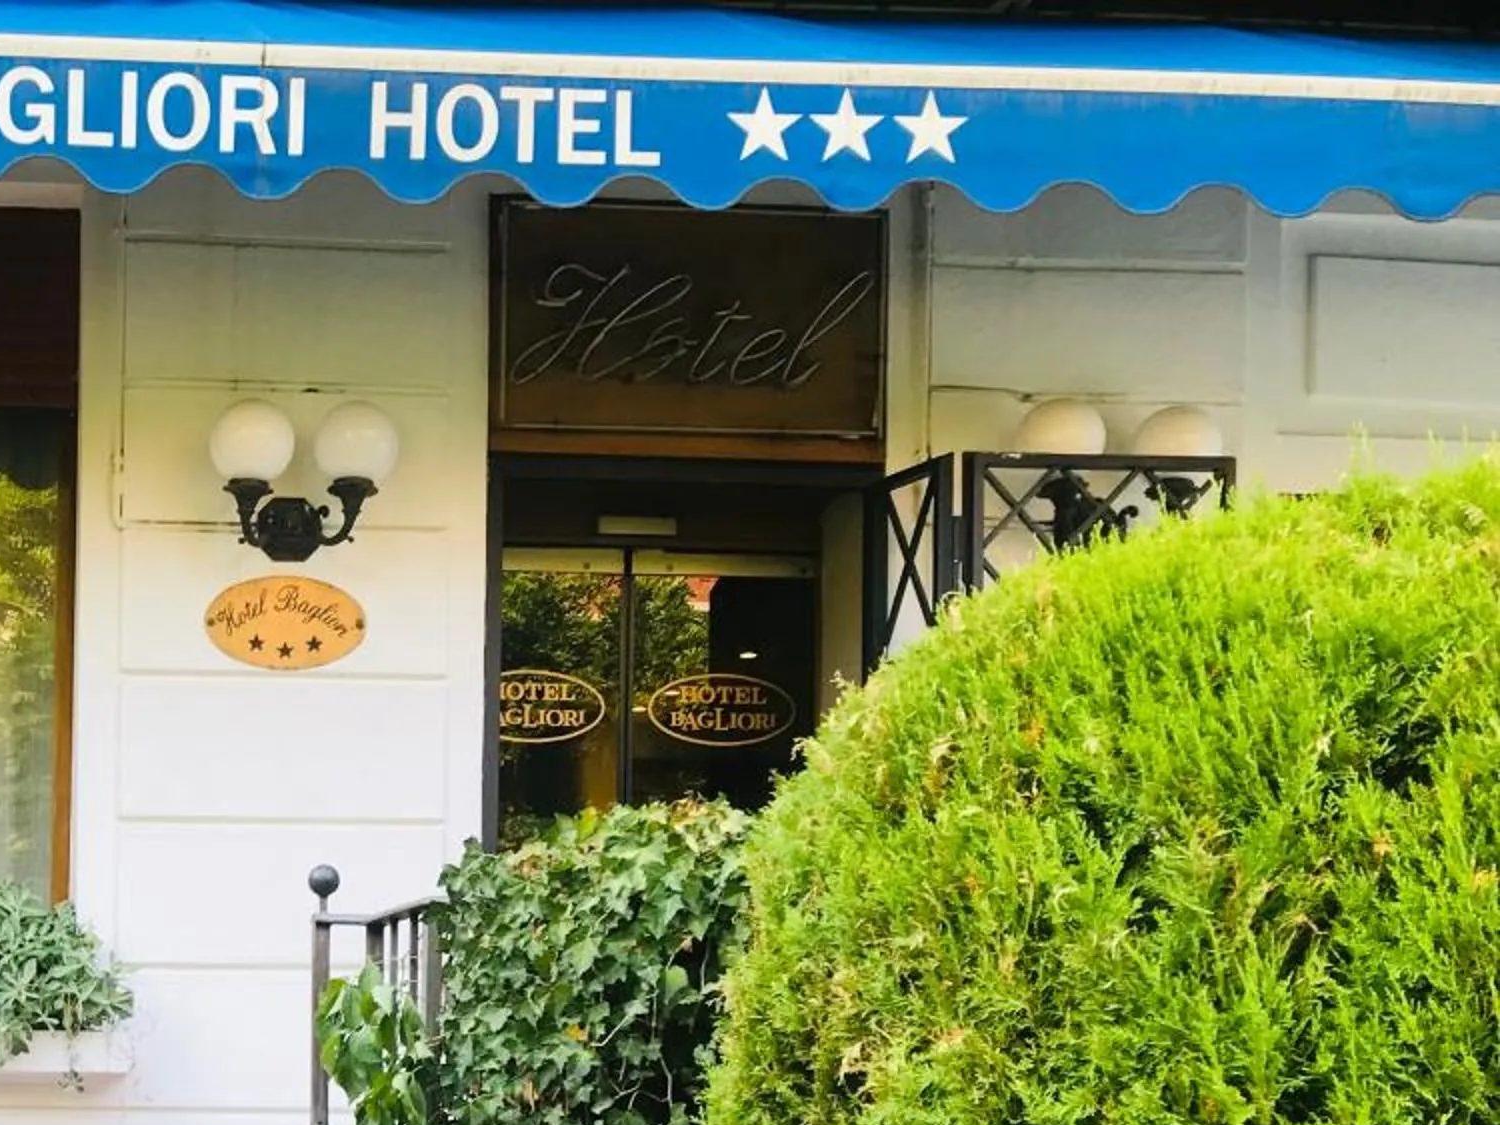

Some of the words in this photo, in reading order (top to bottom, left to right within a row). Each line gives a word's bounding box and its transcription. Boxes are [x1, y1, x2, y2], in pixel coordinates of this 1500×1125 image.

[369, 80, 661, 167] HOTEL
[511, 263, 874, 386] Hotel
[215, 587, 268, 637] Hotel
[669, 707, 776, 732] BAGLIORI
[679, 685, 767, 705] HOTEL
